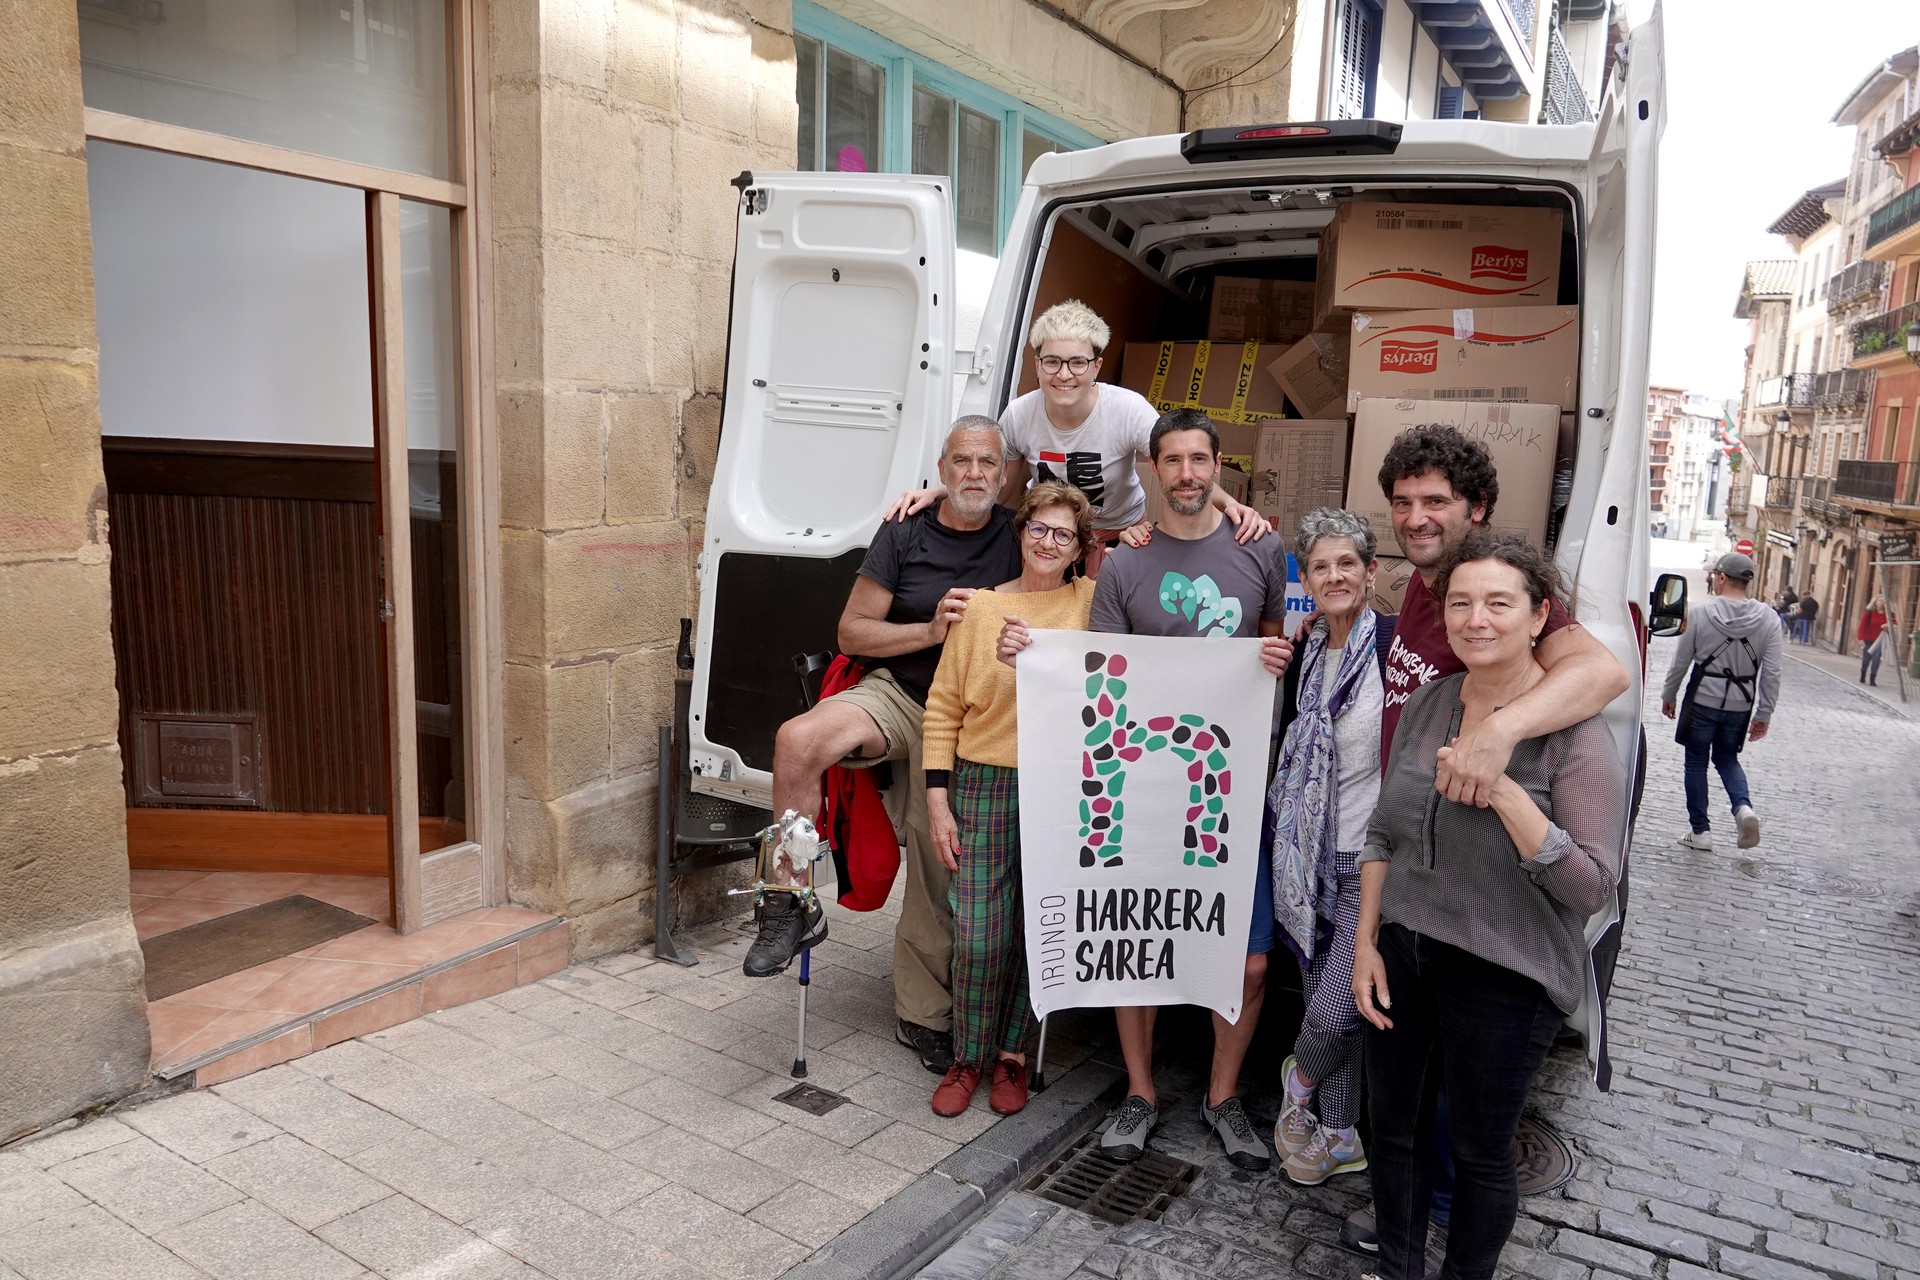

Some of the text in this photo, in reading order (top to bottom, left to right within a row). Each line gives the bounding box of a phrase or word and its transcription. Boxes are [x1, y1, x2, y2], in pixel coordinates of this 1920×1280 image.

[1376, 210, 1405, 218] 210584
[1473, 253, 1526, 274] Berlys
[1157, 344, 1172, 376] HOTZ
[1383, 347, 1436, 367] Berlys
[1189, 367, 1203, 400] HOTZ
[1236, 363, 1252, 397] HOTZ
[1075, 888, 1226, 937] HARRERA
[1040, 895, 1066, 990] IRUNGO
[1075, 939, 1175, 983] SAREA
